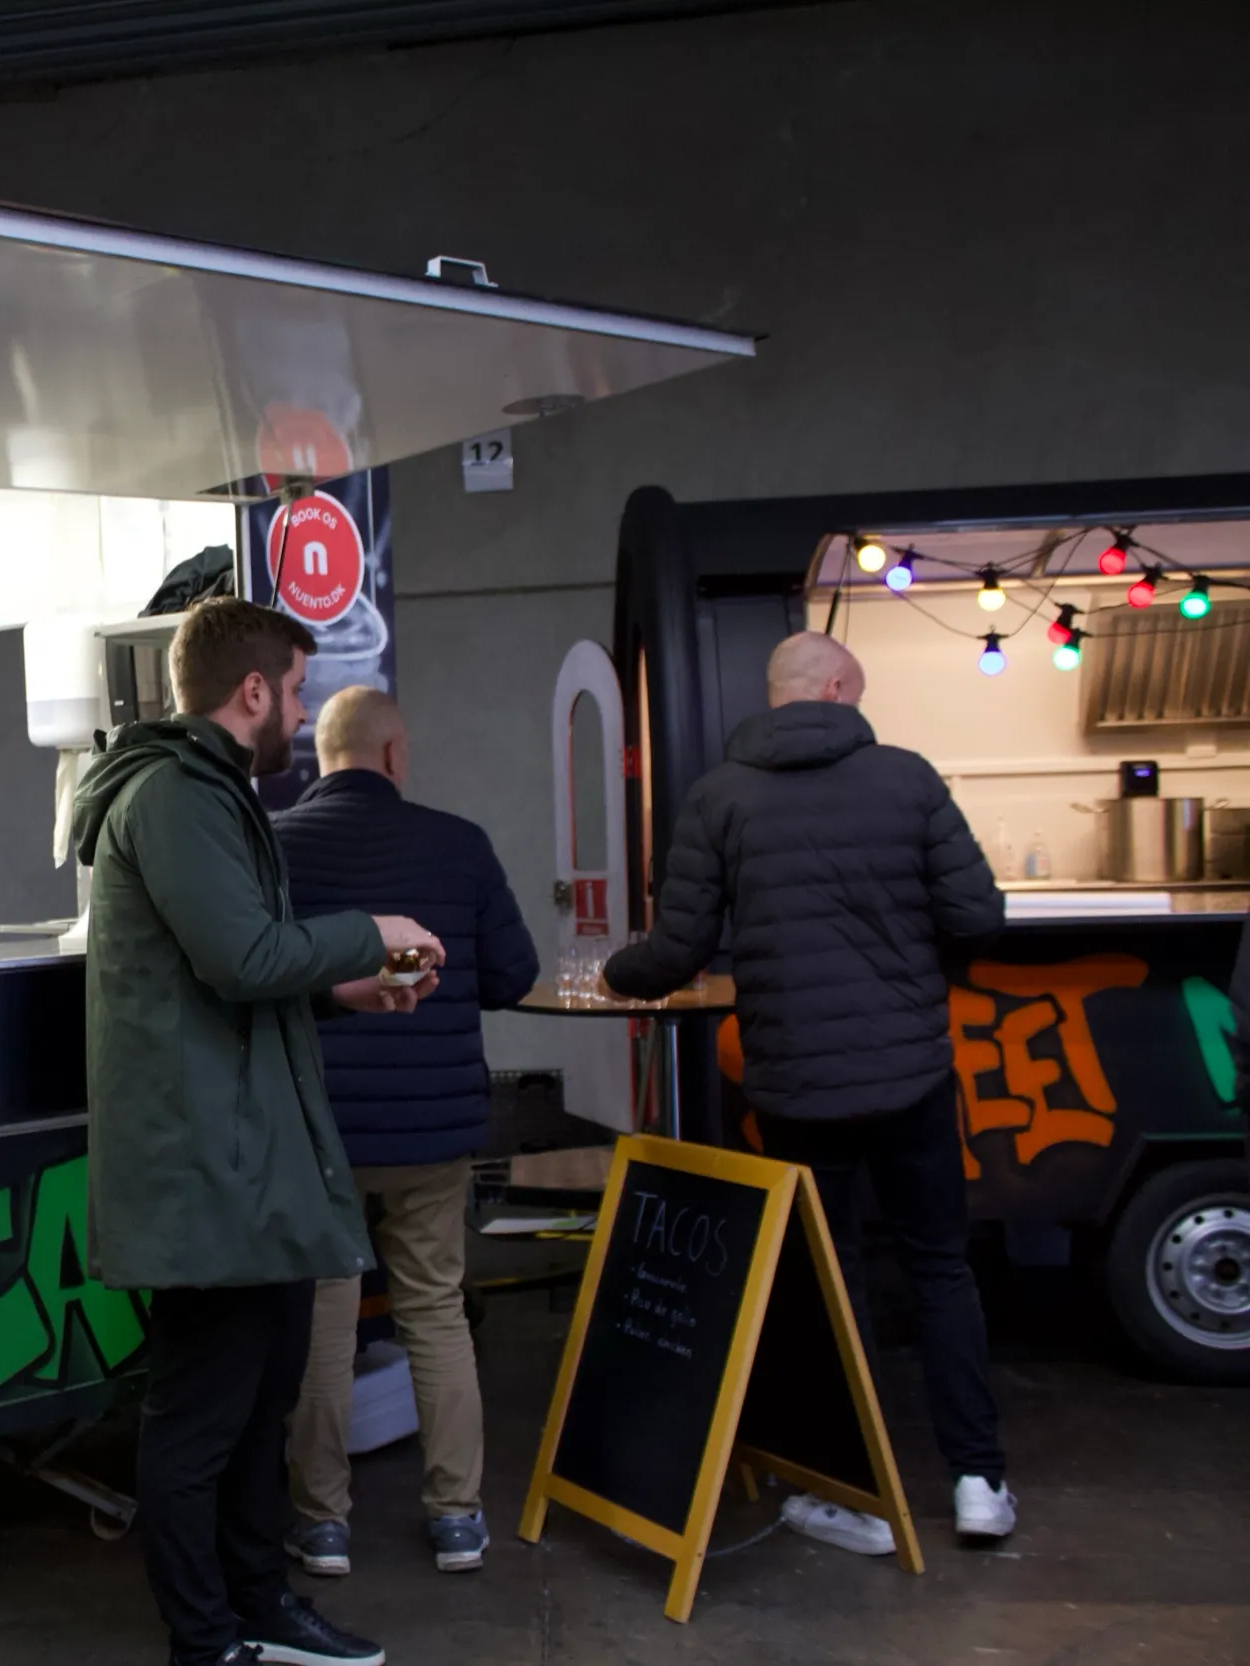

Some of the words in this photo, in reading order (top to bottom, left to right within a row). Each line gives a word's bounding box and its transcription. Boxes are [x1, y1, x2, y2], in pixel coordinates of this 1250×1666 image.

[470, 440, 504, 466] 12
[290, 508, 321, 527] BOOK
[634, 1191, 728, 1277] TACOS
